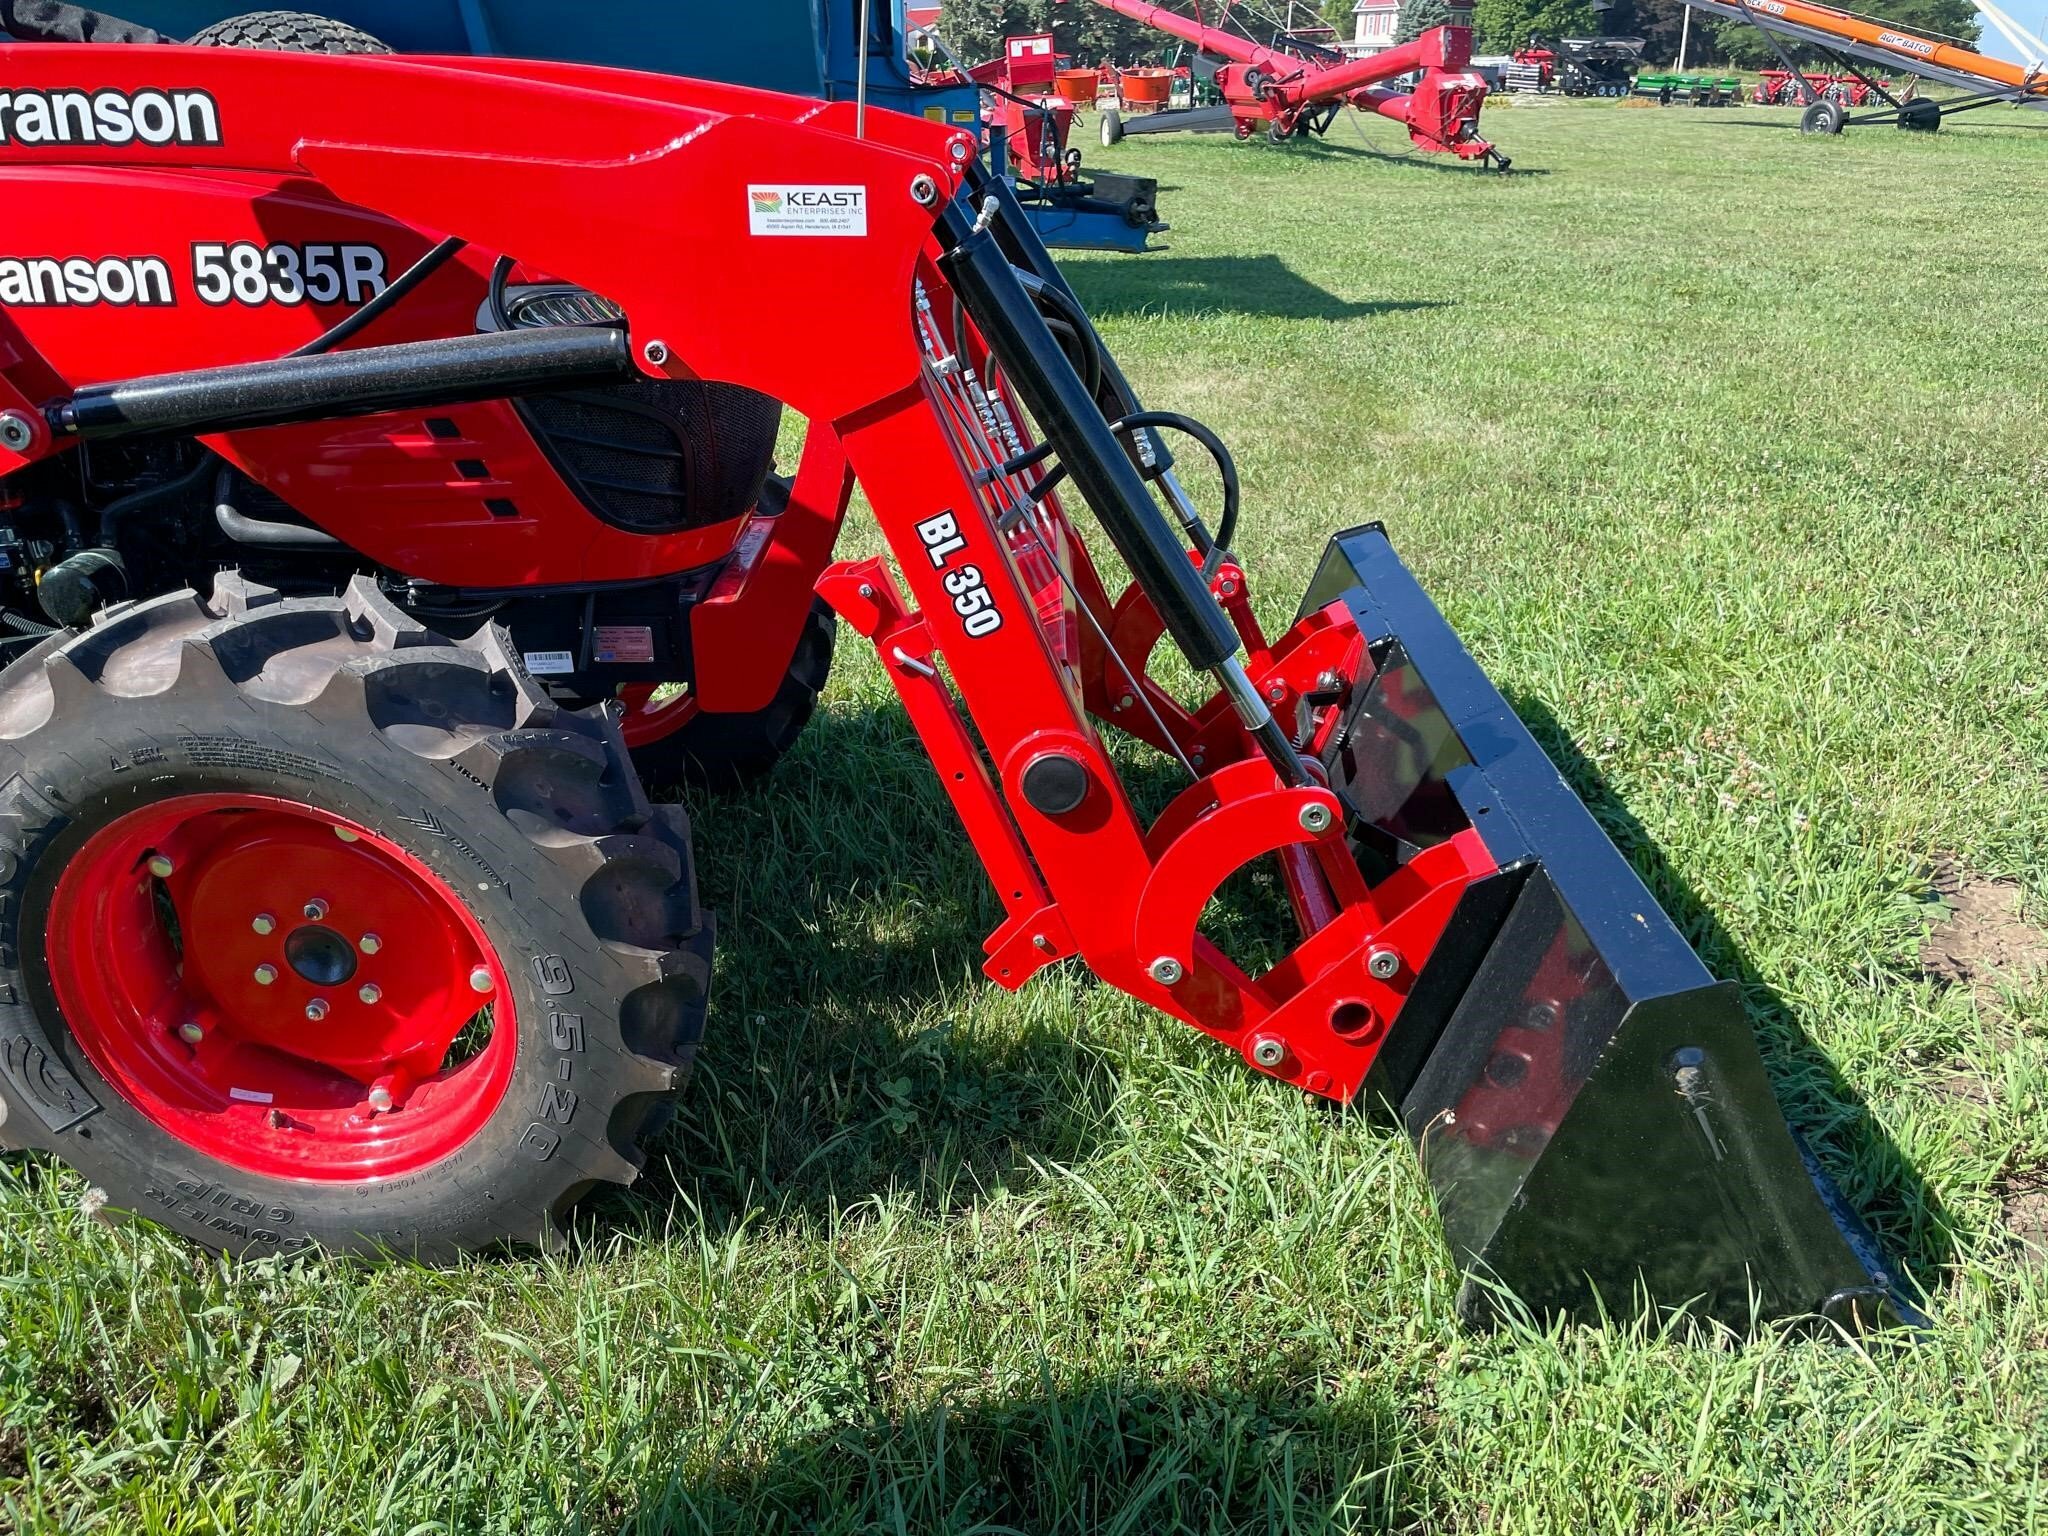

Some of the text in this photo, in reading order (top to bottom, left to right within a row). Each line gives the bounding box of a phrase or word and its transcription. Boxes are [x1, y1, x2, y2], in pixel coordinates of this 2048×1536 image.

[1880, 33, 1931, 53] AGI BATCO
[787, 192, 862, 206] KEAST
[787, 207, 863, 215] ENTERPRISES INC
[195, 244, 387, 304] 5835R
[916, 510, 1002, 638] BL 350
[518, 954, 586, 1162] 9.5-20
[143, 1186, 309, 1250] POWER
[175, 1179, 296, 1226] GRIP
